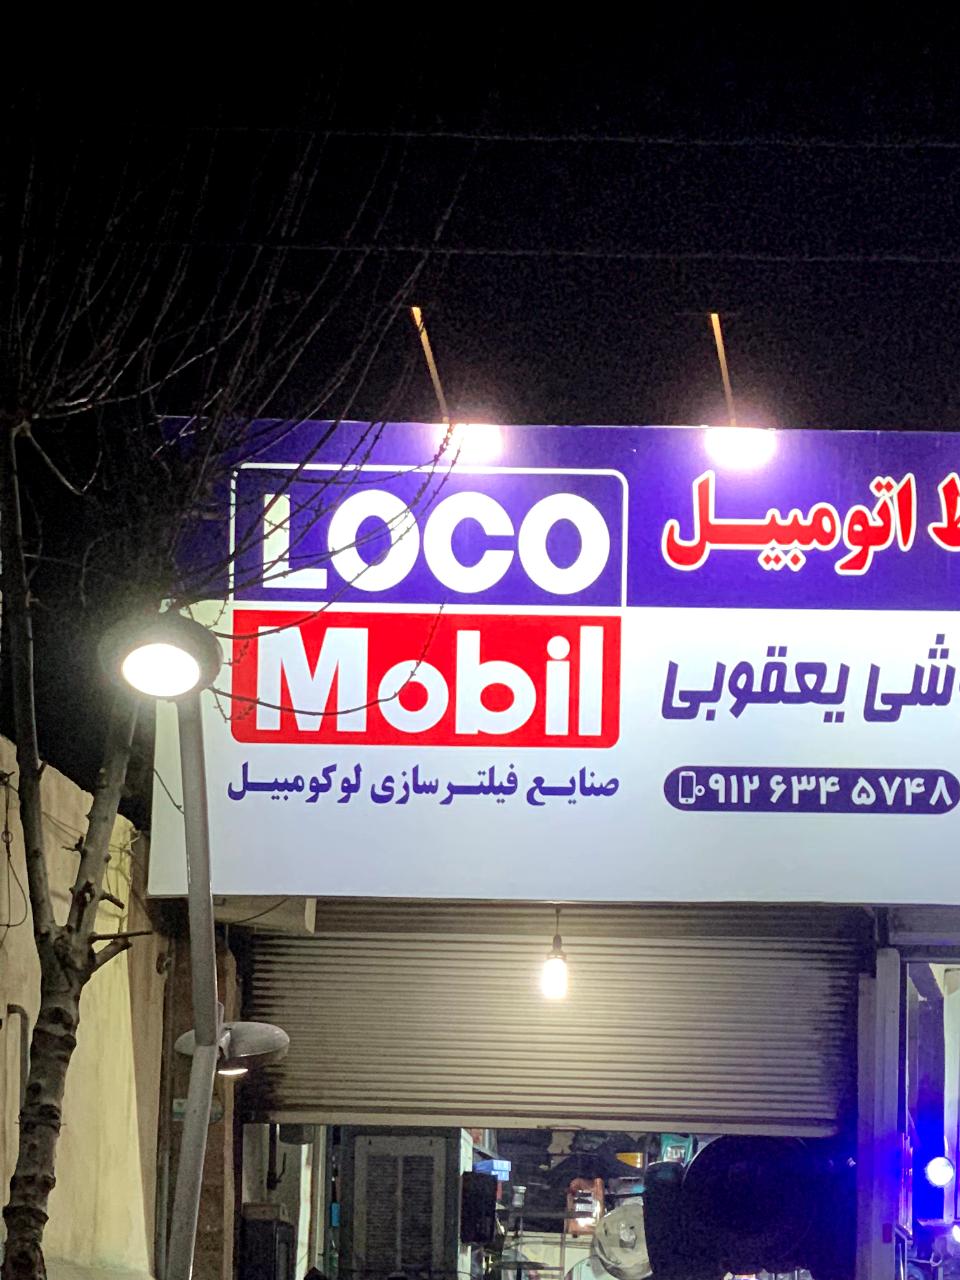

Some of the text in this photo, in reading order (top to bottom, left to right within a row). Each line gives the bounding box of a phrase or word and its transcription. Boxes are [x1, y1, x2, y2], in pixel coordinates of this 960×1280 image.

[262, 488, 611, 595] LOCO
[661, 469, 917, 576] اتومبیل
[255, 626, 605, 737] Mobil
[661, 645, 851, 724] یعقوبی
[228, 761, 362, 804] لوکومبیل
[526, 765, 620, 806] صنایع
